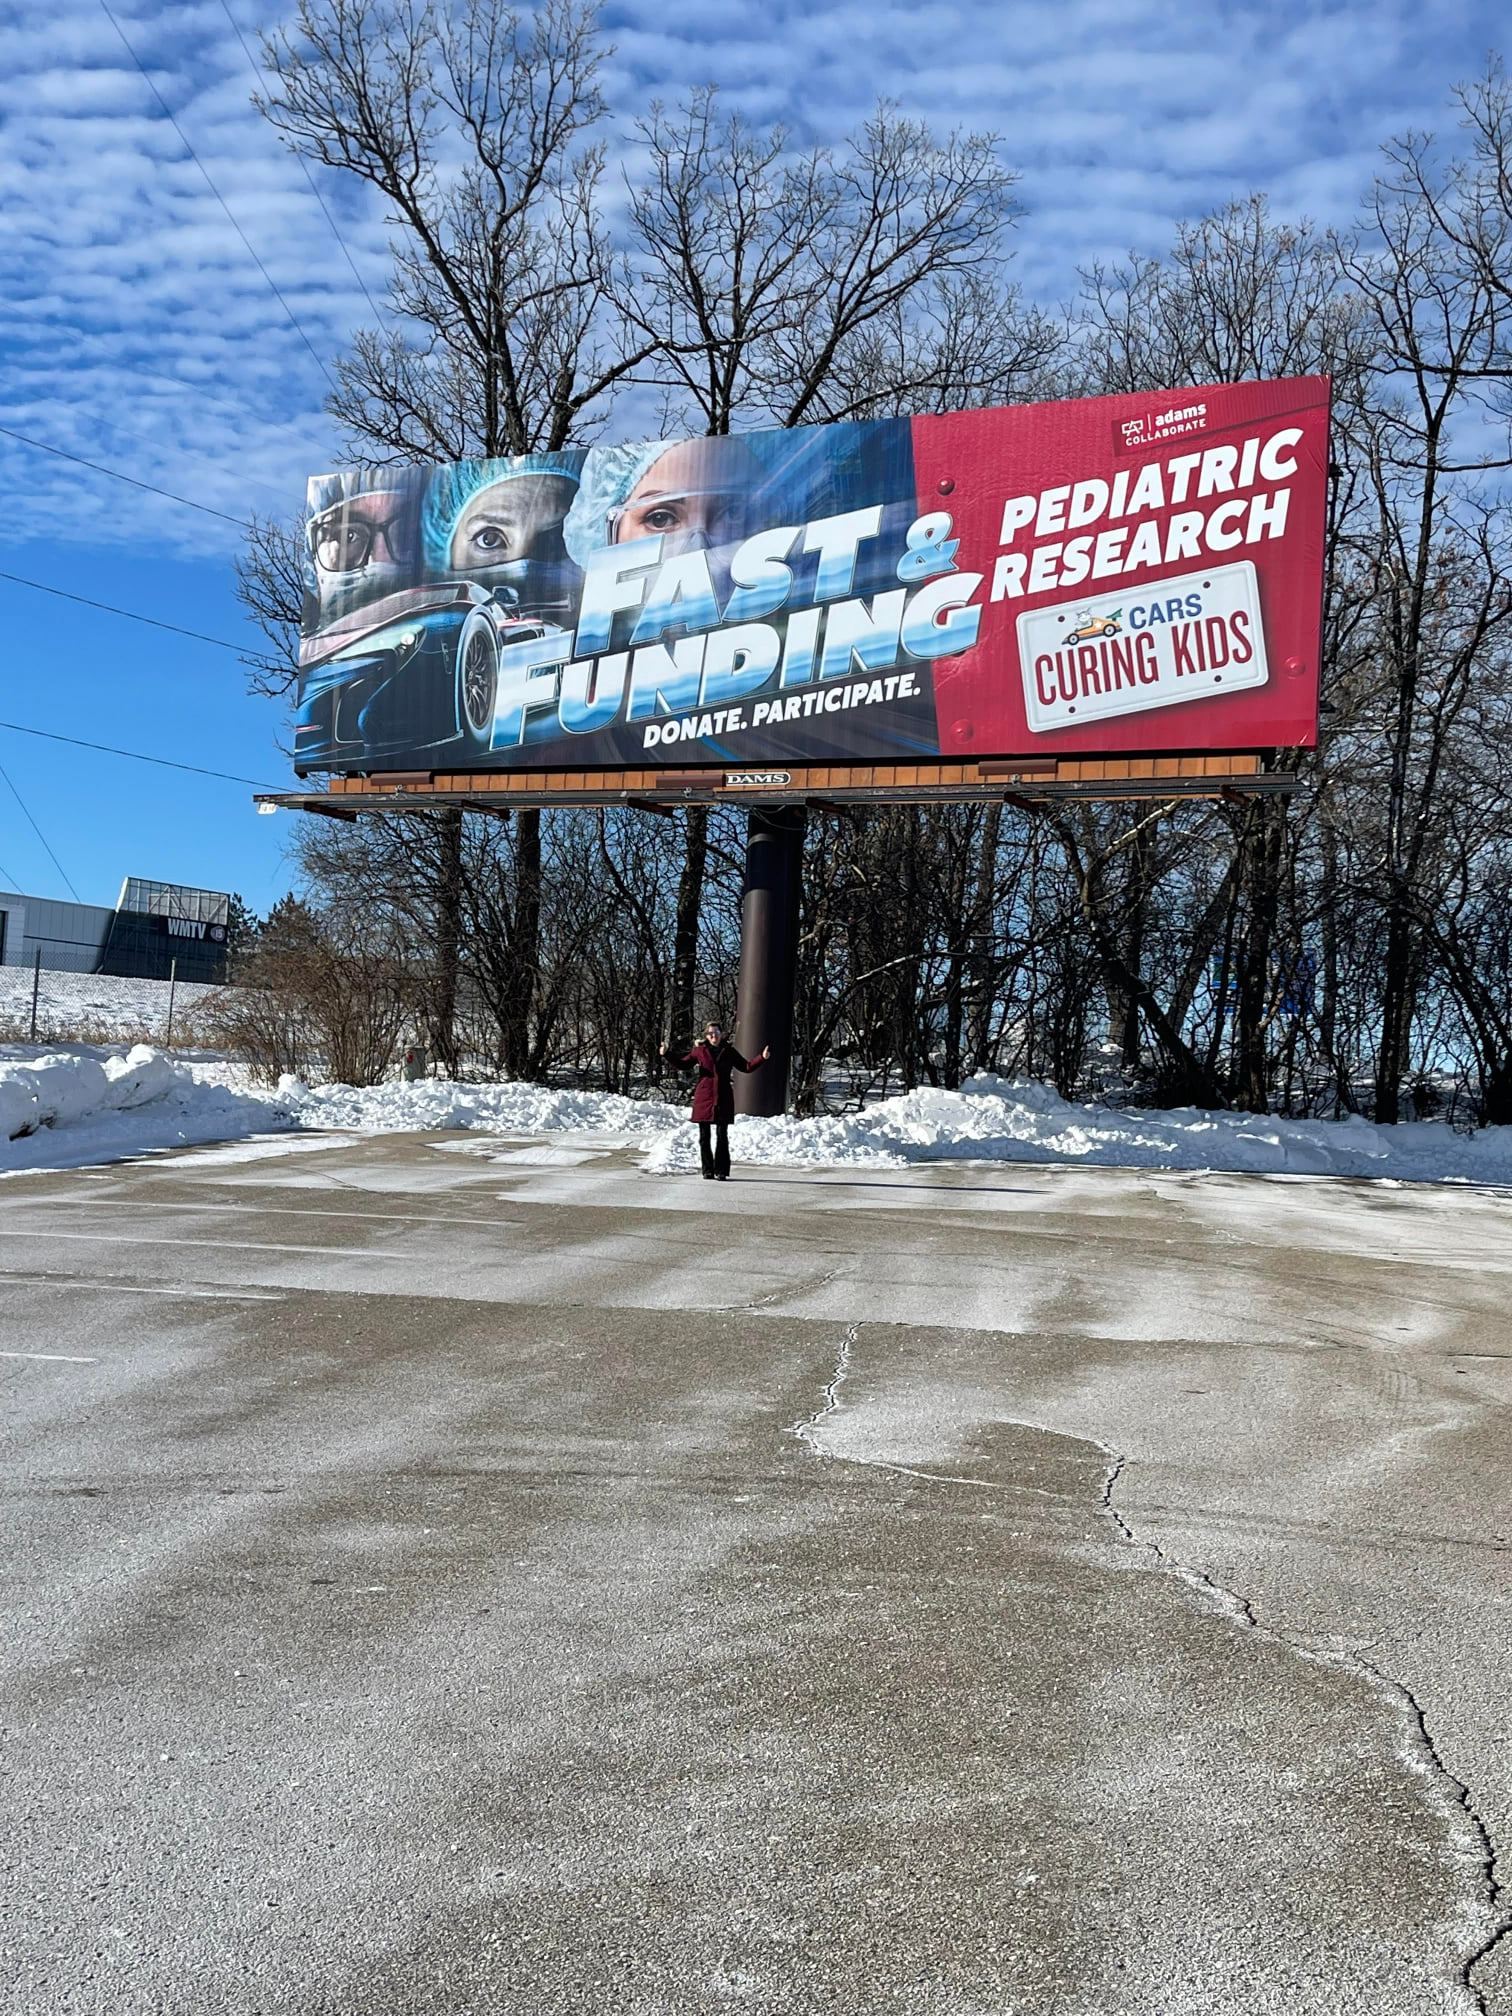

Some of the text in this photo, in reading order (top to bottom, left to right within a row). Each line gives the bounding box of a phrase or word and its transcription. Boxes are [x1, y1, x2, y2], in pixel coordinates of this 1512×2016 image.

[1125, 418, 1207, 447] COLLABORATE
[1155, 403, 1207, 426] adams
[999, 428, 1304, 546] PEDIATRIC
[574, 504, 960, 658] FAST &
[990, 489, 1291, 603] RESEARCH
[1129, 594, 1203, 630] CARS
[489, 573, 984, 751] FUNDING
[1035, 611, 1254, 706] CURING KIDS
[643, 673, 921, 749] DONATE. PARTICIPATE.
[727, 774, 784, 784] DAMS
[168, 918, 207, 939] WMTV
